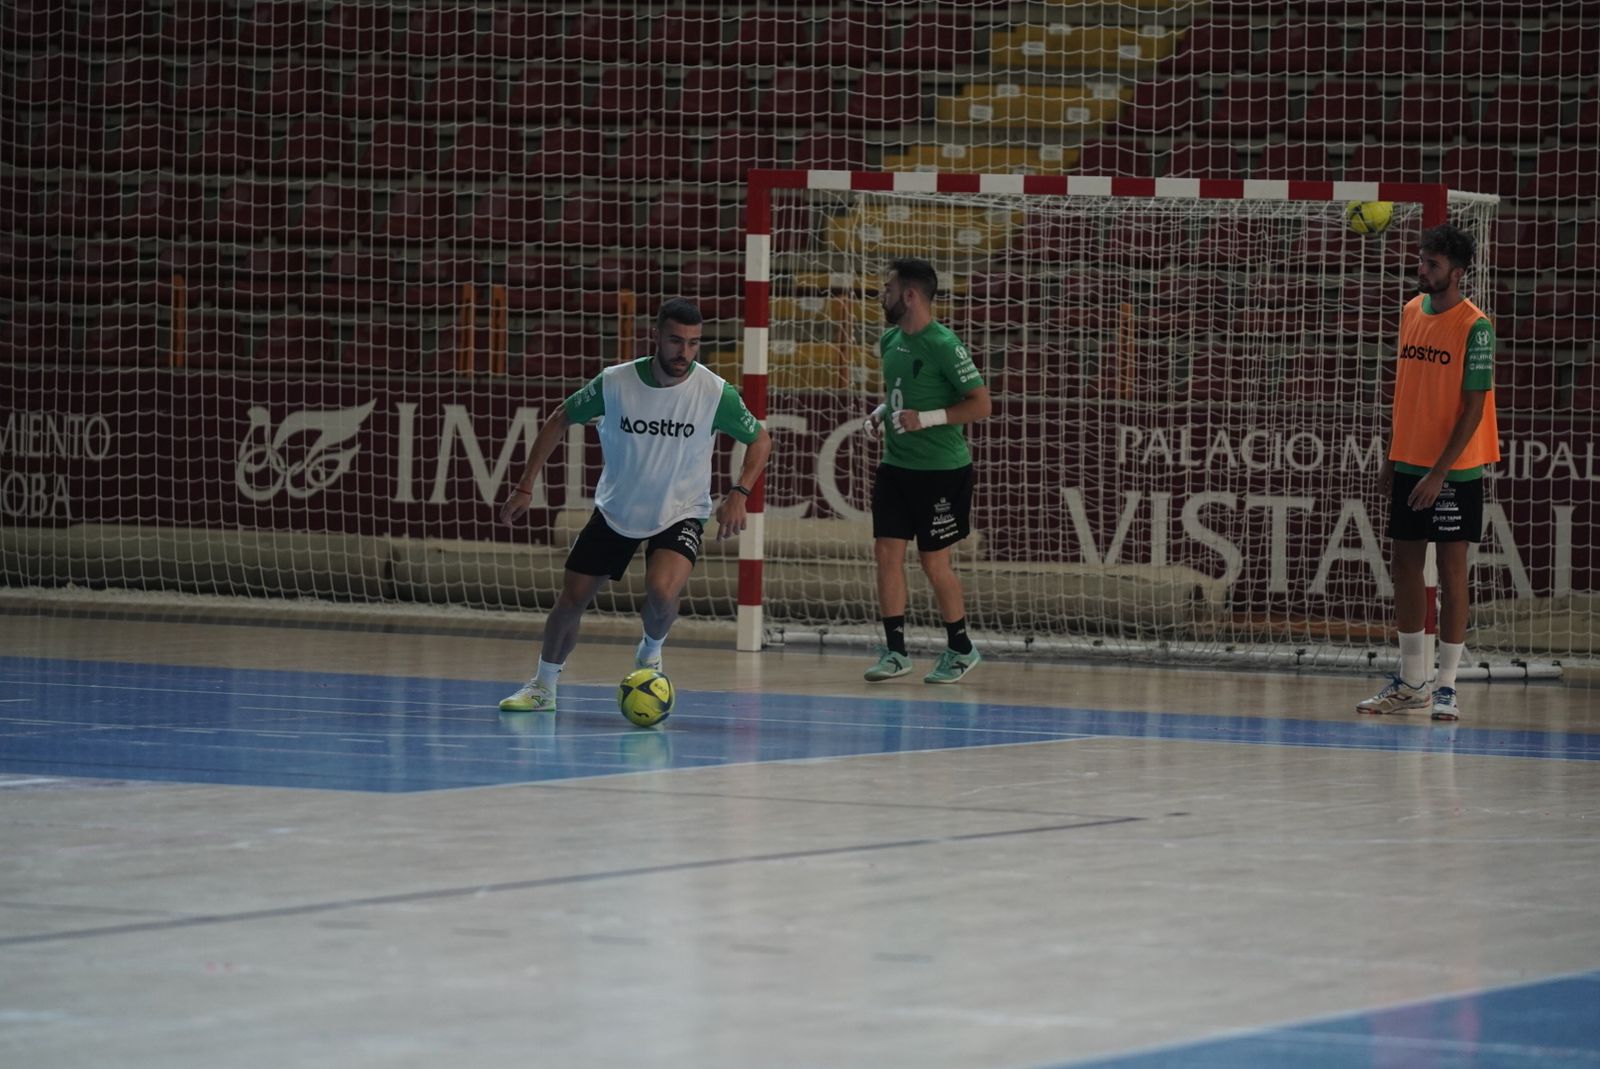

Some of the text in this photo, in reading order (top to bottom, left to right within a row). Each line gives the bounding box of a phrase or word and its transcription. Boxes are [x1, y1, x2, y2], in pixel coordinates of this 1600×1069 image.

[1400, 344, 1451, 365] ostro
[620, 416, 695, 437] Mosttro
[1118, 425, 1325, 472] PALACIO
[1061, 487, 1395, 599] VISTA
